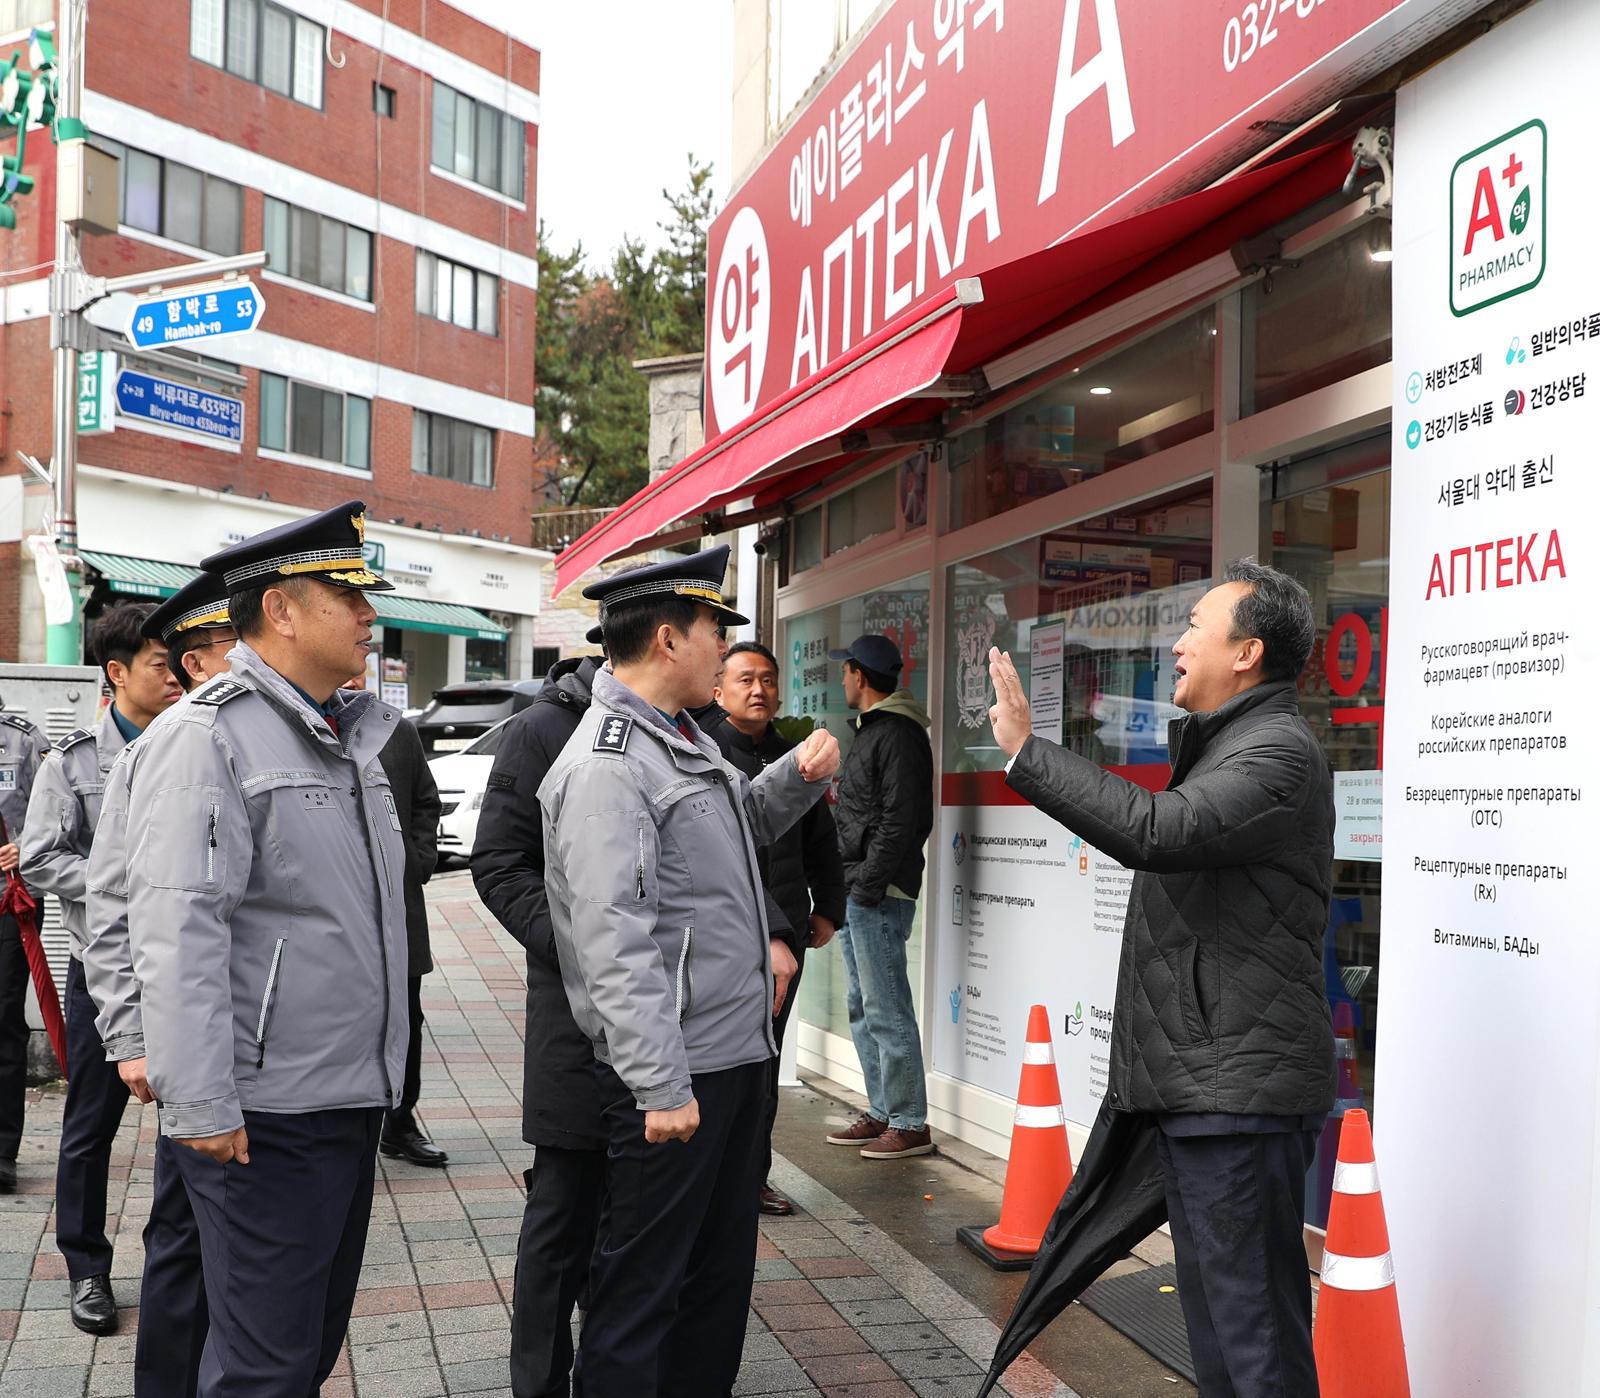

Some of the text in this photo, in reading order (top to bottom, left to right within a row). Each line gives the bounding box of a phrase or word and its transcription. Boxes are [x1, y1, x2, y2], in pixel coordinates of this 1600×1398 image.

[788, 21, 926, 228] 에이플러스
[1513, 201, 1527, 223] 약
[790, 99, 1001, 389] АПТЕКА
[1459, 244, 1534, 291] PHARMACY
[236, 300, 252, 318] 53
[137, 316, 153, 333] 49
[164, 321, 221, 341] Hambak-ro
[721, 243, 760, 405] 약
[1531, 313, 1600, 357] 일반의약품
[1425, 353, 1483, 391] 처방전조제
[1530, 372, 1586, 410] 건강상담
[1424, 401, 1494, 442] 건강기능식품
[1437, 454, 1553, 507] 서울대 약대 출신
[1425, 529, 1566, 600] АПТЕКА
[1421, 630, 1569, 664] Русскоговорящий врач-
[1423, 654, 1565, 687] фармацевт (провизор)
[1431, 710, 1552, 734] Корейские аналоги
[1418, 734, 1567, 758] российских препаратов
[1405, 786, 1581, 806] Безрецептурные препараты
[1007, 836, 1047, 850] консультация
[1414, 856, 1567, 883] Рецептурные препараты
[969, 889, 1035, 909] Рецептурные препараты
[1474, 883, 1497, 903] (Rx)
[1434, 928, 1540, 957] Витамины, БАДы
[967, 985, 981, 999] БАДы
